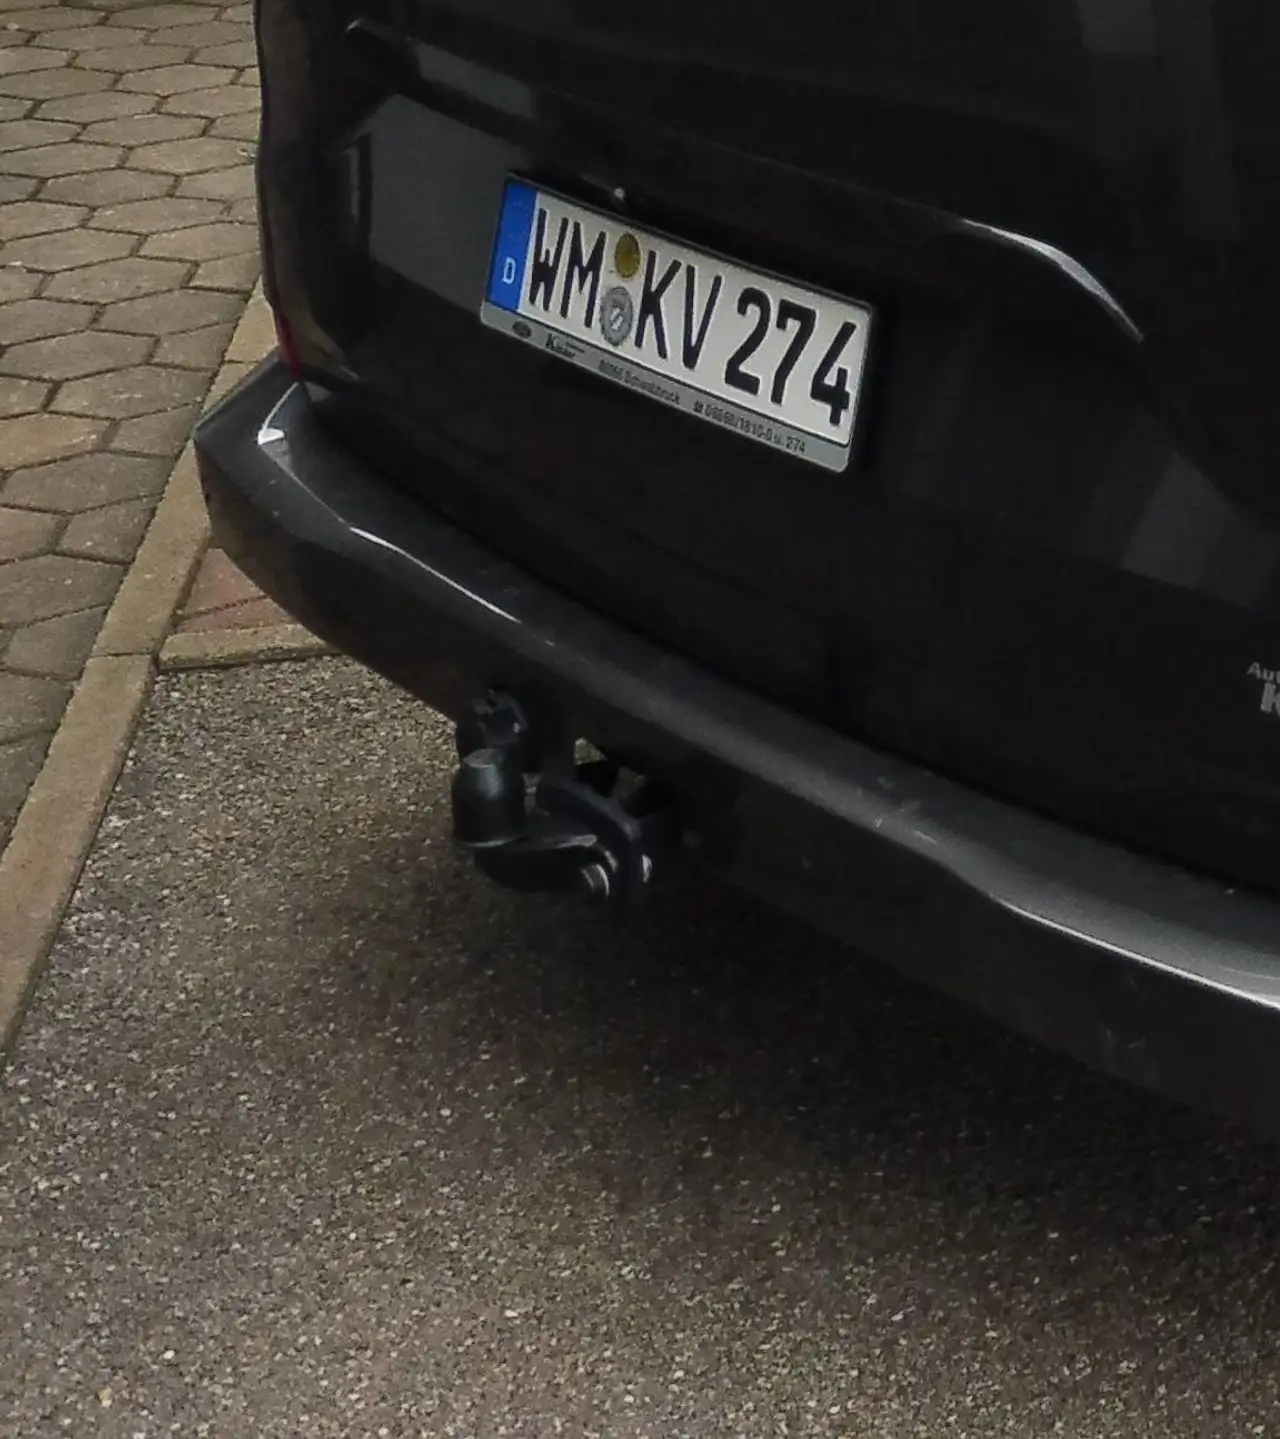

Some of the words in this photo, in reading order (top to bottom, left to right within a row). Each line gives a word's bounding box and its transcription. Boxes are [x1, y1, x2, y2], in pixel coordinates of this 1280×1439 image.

[501, 257, 516, 285] D
[528, 207, 607, 329] WM
[634, 249, 723, 371] KV
[724, 286, 858, 427] 274
